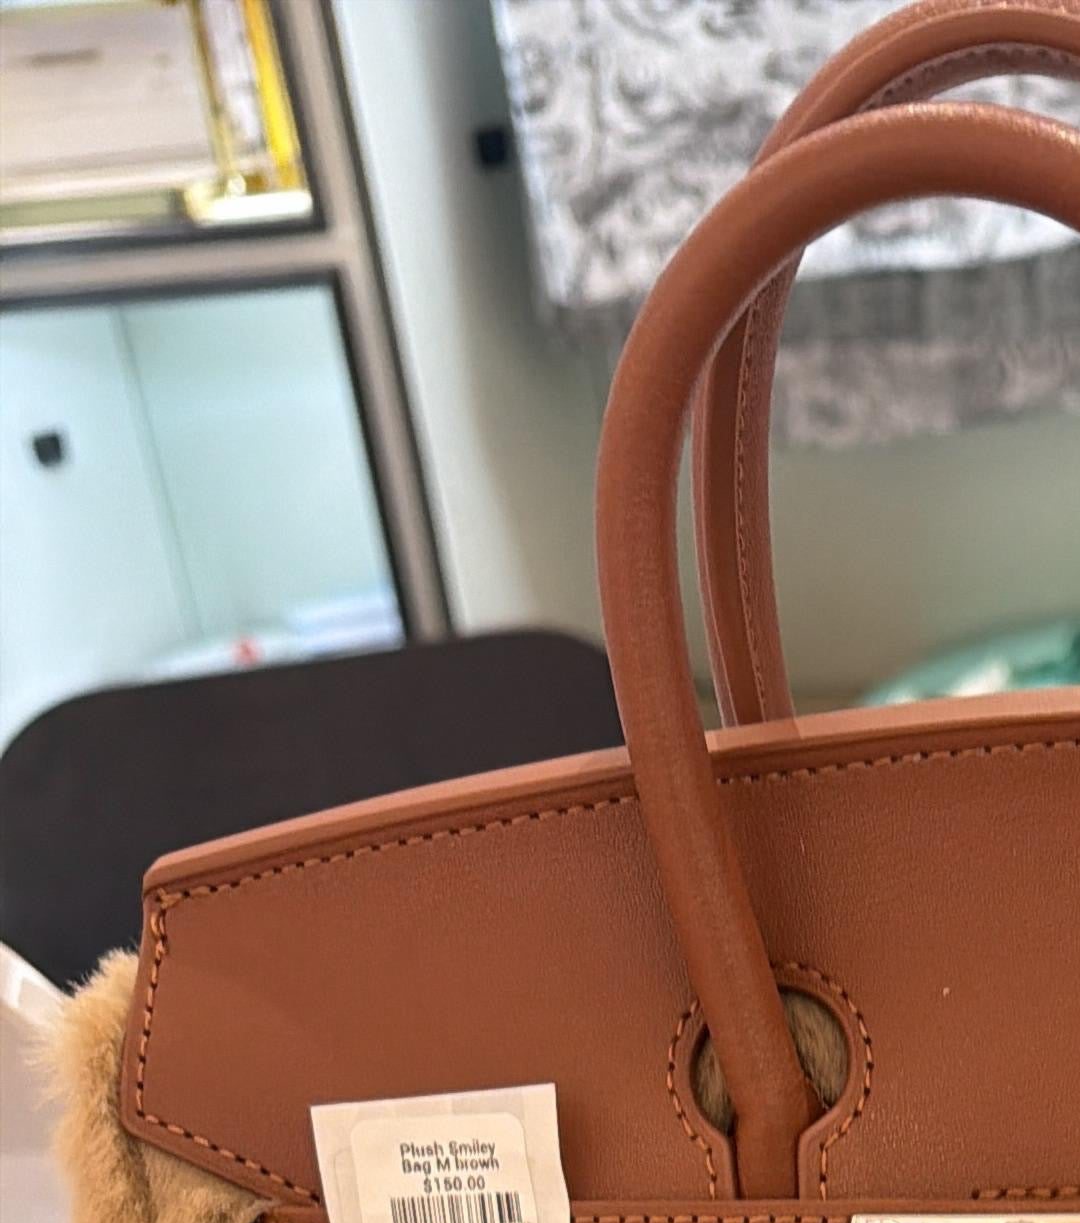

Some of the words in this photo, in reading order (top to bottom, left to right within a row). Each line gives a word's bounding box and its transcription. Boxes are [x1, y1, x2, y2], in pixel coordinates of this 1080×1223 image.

[400, 1140, 444, 1158] Plush
[449, 1138, 496, 1159] Smiley
[401, 1158, 432, 1175] Bag
[437, 1157, 451, 1172] M
[455, 1154, 499, 1171] brown
[423, 1174, 486, 1194] $150.00
